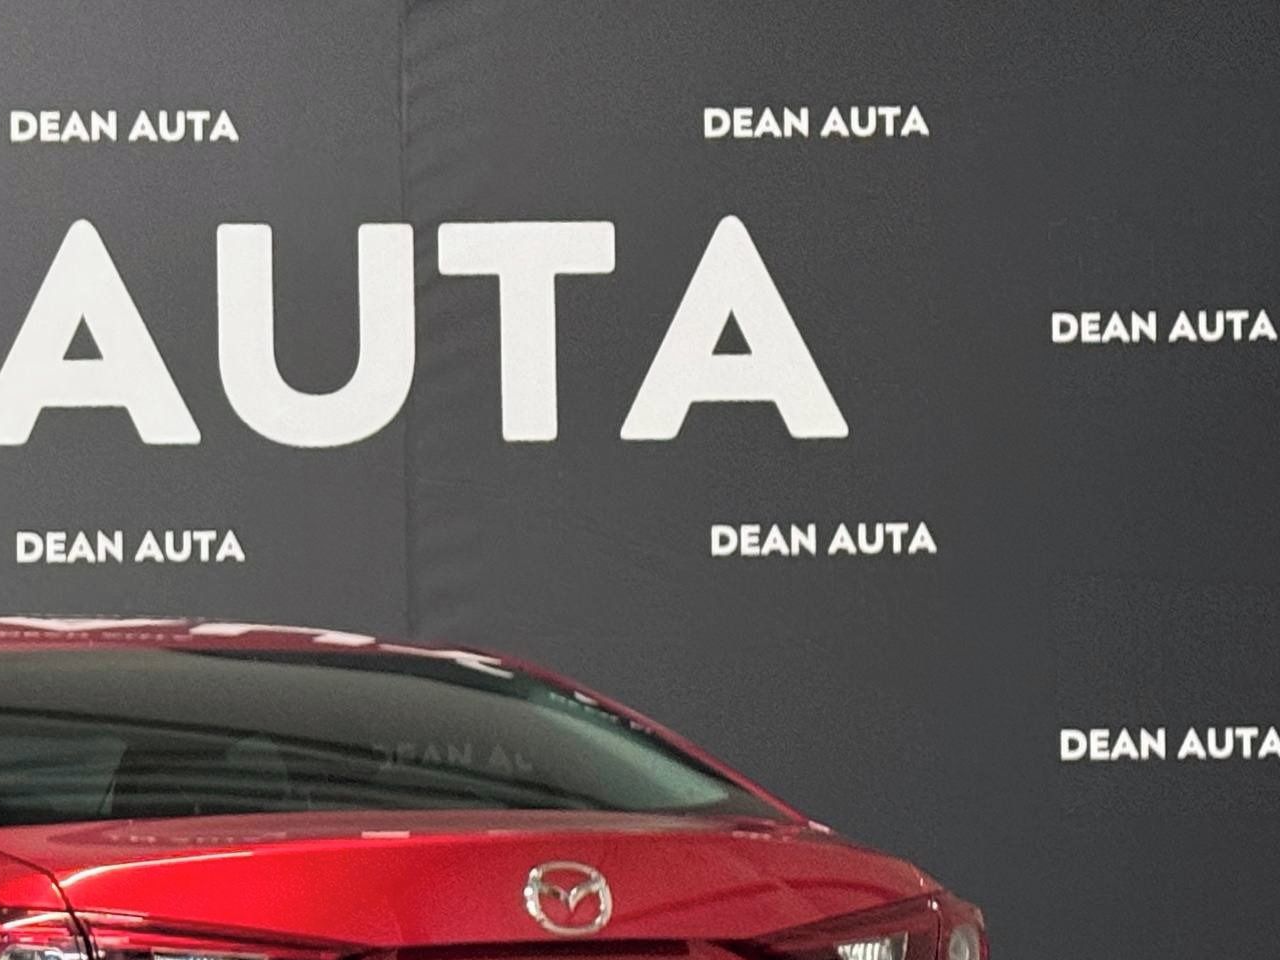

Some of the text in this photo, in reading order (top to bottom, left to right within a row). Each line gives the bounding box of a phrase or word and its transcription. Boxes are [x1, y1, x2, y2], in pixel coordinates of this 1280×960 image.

[9, 109, 240, 144] DEAN AUTA
[703, 105, 930, 139] DEAN AUTA
[1051, 309, 1278, 344] DEAN AUTA
[15, 529, 246, 564] DEAN AUTA
[710, 521, 938, 557] DEAN AUTA
[1060, 726, 1280, 761] DEAN AUTA
